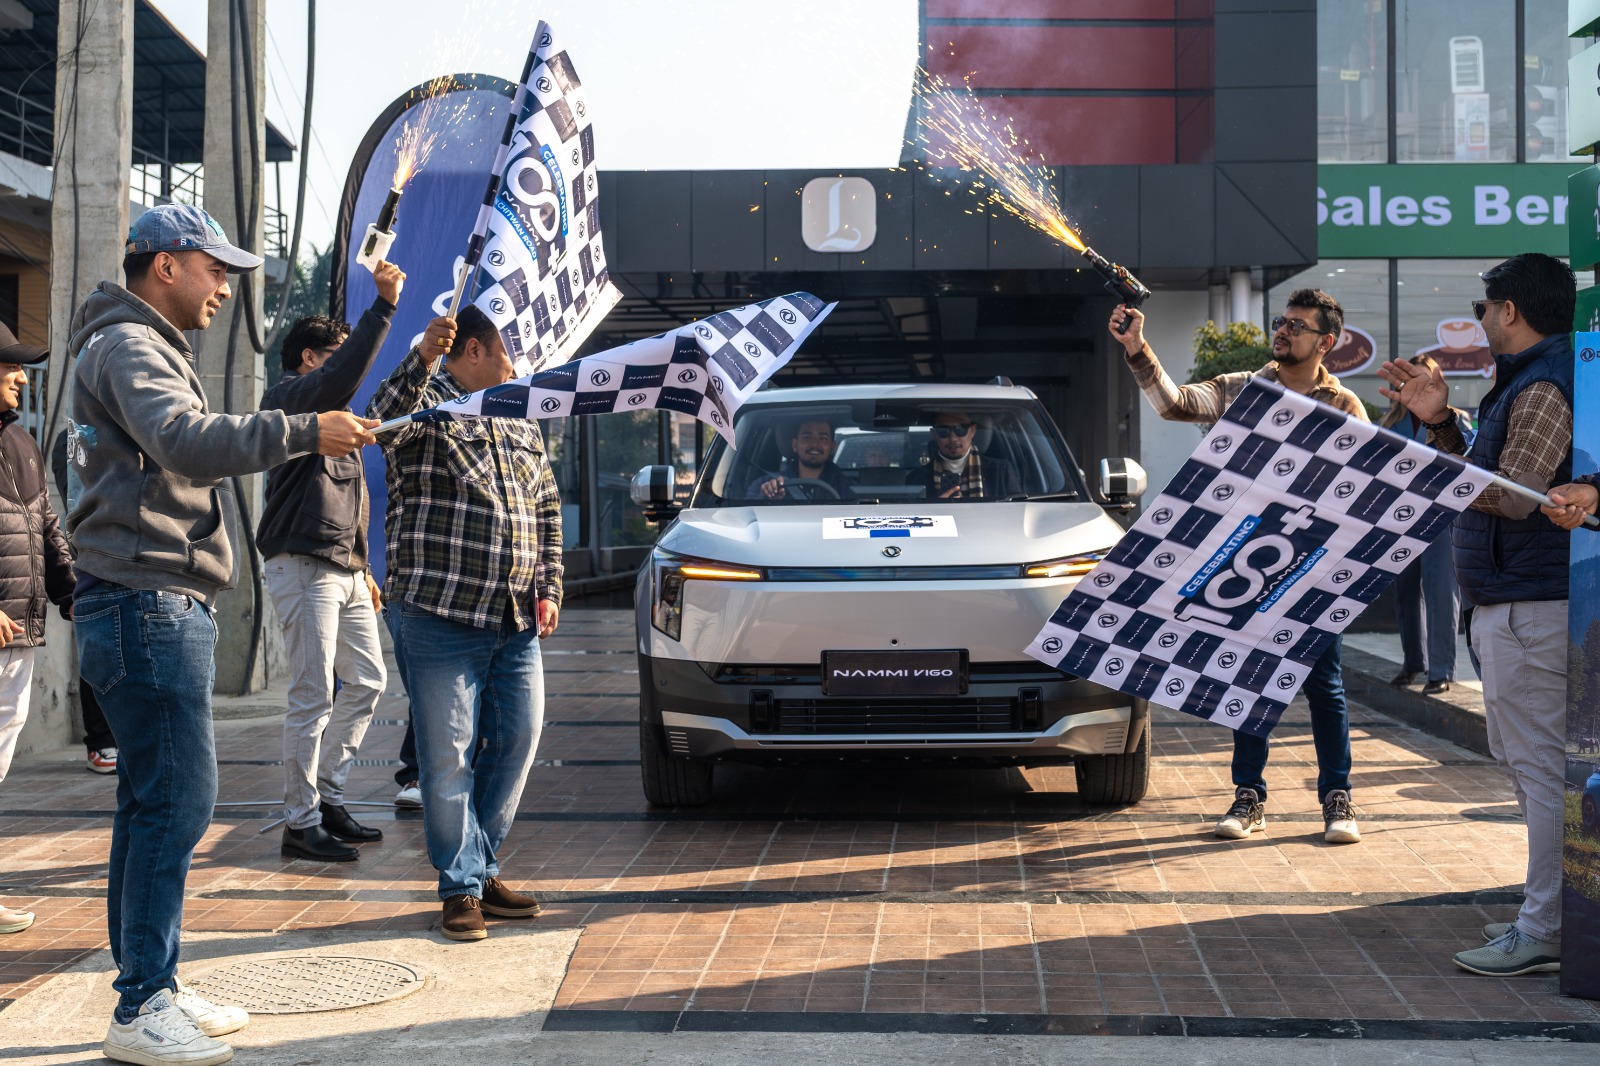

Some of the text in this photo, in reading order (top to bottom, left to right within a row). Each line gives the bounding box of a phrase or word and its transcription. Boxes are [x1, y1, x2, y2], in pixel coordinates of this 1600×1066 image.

[502, 190, 540, 247] NAMMI
[543, 150, 568, 232] CELEBRATING
[818, 180, 862, 250] L
[497, 202, 537, 259] CHITWAN ROAD
[488, 397, 523, 405] NAMMI
[1185, 520, 1255, 593] CELEBRATING
[1256, 551, 1309, 602] NAMMI
[1259, 549, 1325, 612] ON CHITWAN ROAD
[833, 669, 954, 677] NAMMI VIGO
